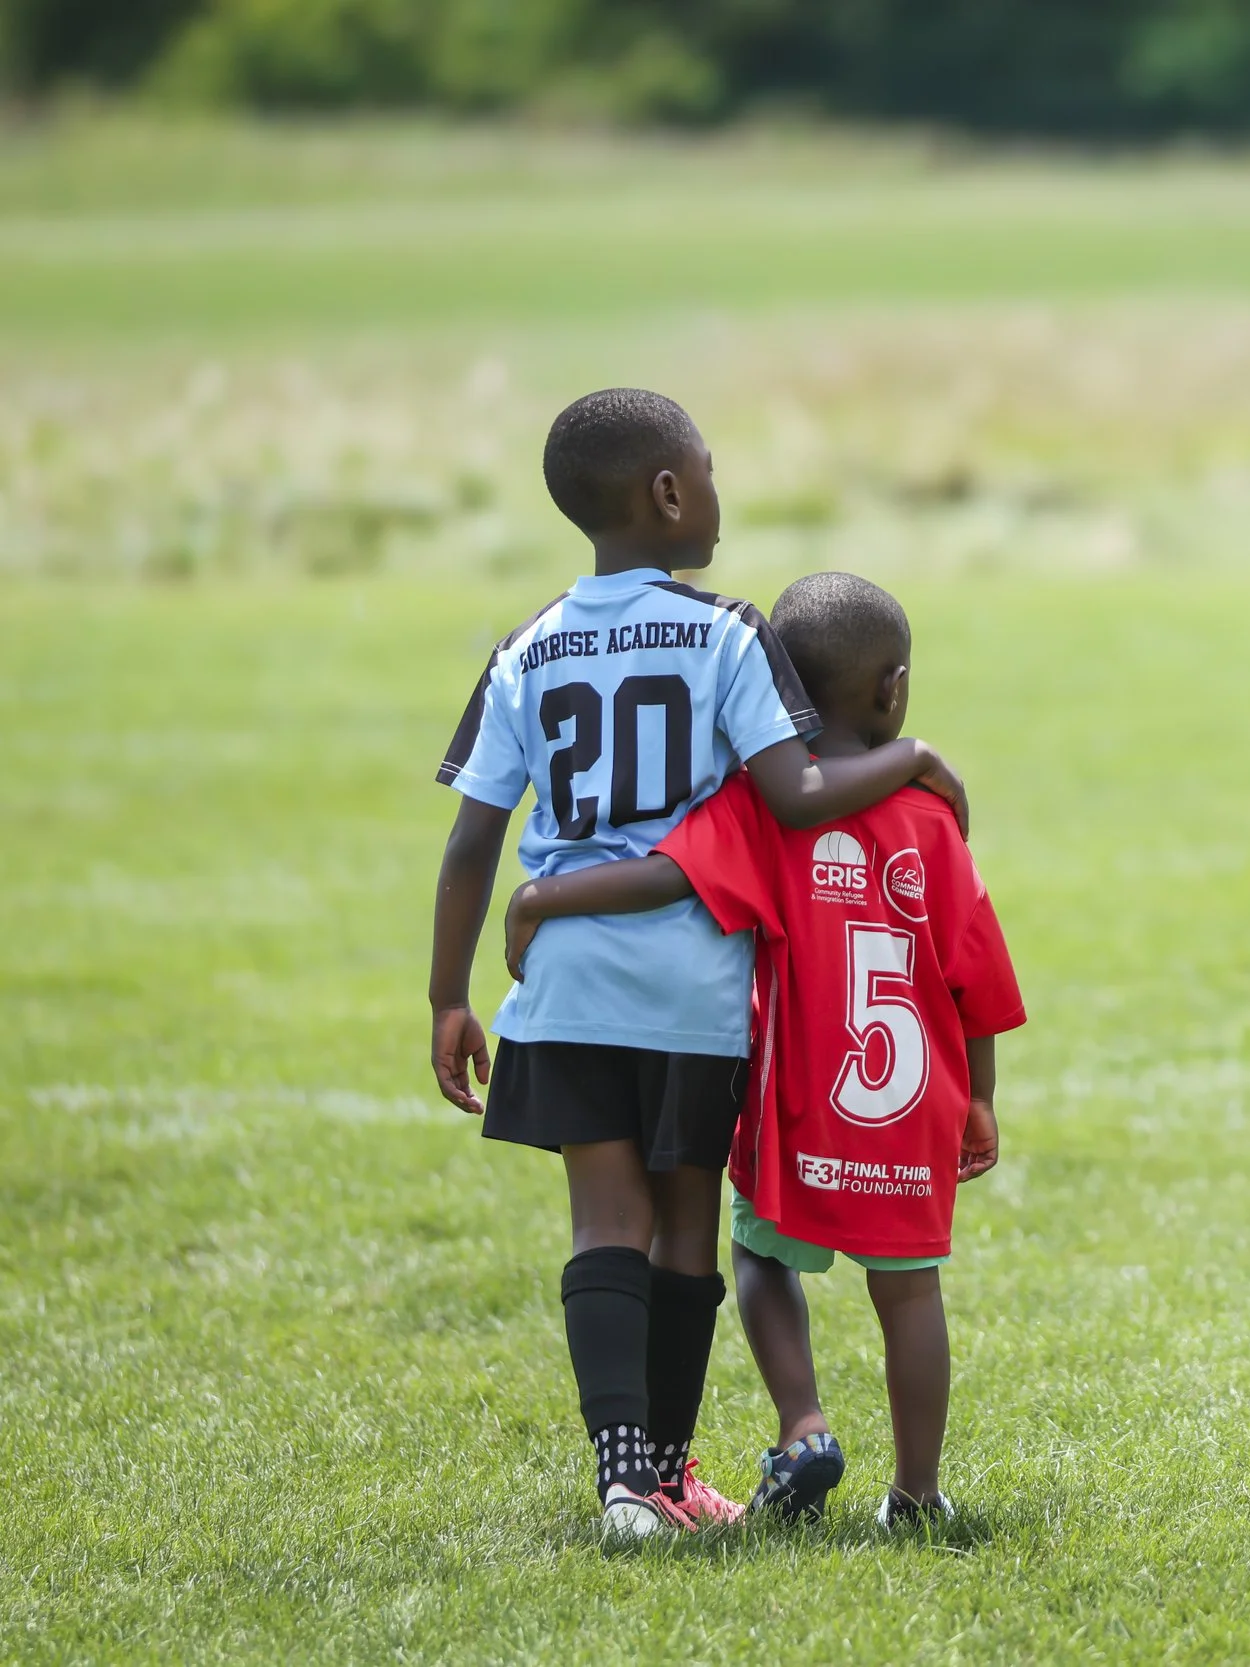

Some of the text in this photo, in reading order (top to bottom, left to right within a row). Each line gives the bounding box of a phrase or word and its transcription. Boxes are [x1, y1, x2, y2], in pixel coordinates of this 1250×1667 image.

[519, 621, 712, 675] SUNRISE ACADEMY
[538, 674, 693, 840] 20
[812, 863, 867, 889] CRIS
[841, 891, 864, 900] Refugee
[845, 898, 868, 906] Services
[829, 920, 930, 1127] 5
[844, 1161, 931, 1181] FINAL THIRD
[841, 1178, 932, 1197] FOUNDATION
